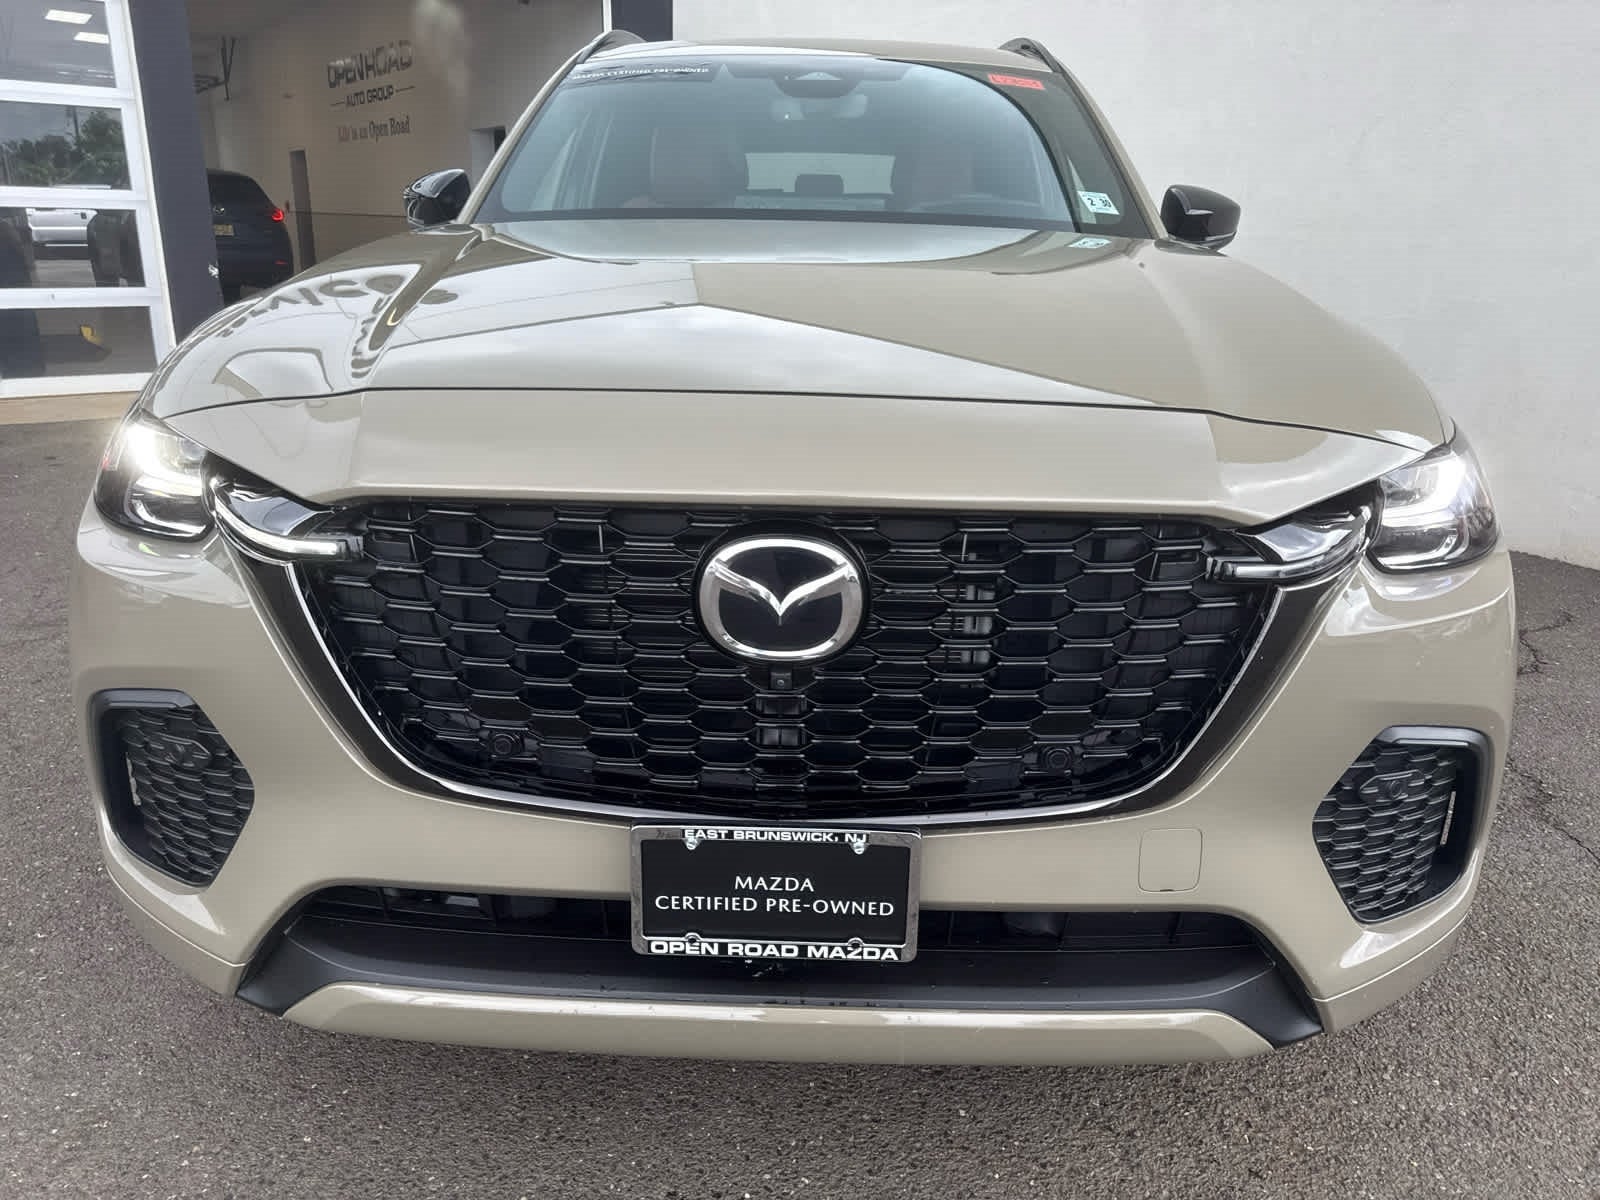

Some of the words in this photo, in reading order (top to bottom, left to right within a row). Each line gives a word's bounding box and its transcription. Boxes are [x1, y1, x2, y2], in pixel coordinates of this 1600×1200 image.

[366, 84, 394, 104] GROUP
[368, 120, 389, 143] Open
[389, 114, 410, 136] Road
[1087, 197, 1097, 206] 2
[684, 829, 728, 840] EAST
[733, 830, 839, 843] BRUNSWICK,
[844, 833, 867, 844] NJ
[734, 875, 815, 893] MAZDA
[655, 895, 758, 912] CERTIFIED
[766, 898, 895, 917] PRE-OWNED
[650, 940, 719, 956] OPEN
[727, 942, 799, 958] ROAD
[807, 944, 899, 961] MAZDA
